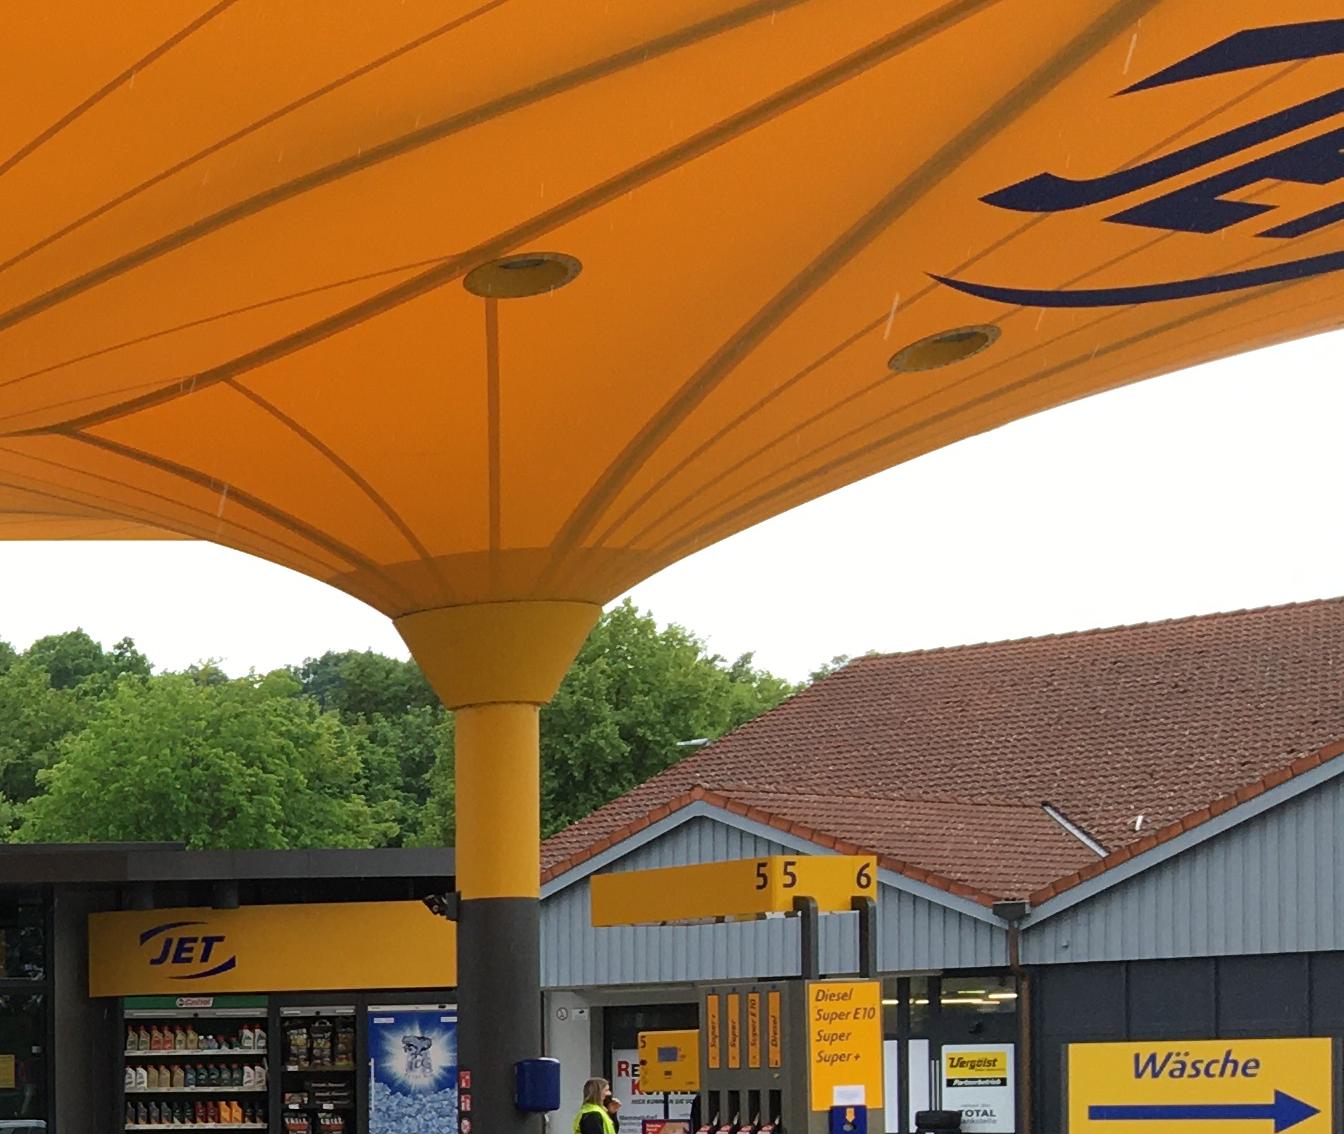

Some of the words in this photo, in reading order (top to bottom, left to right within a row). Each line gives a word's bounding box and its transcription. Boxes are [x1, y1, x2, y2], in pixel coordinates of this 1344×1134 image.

[756, 862, 768, 890] 5
[783, 861, 797, 888] 5
[855, 862, 872, 889] 6
[149, 935, 226, 965] JET
[815, 987, 854, 1003] Diesel
[815, 1008, 852, 1025] Super
[853, 1006, 876, 1020] E10
[815, 1028, 852, 1047] Super
[1133, 1049, 1260, 1079] Wäsche
